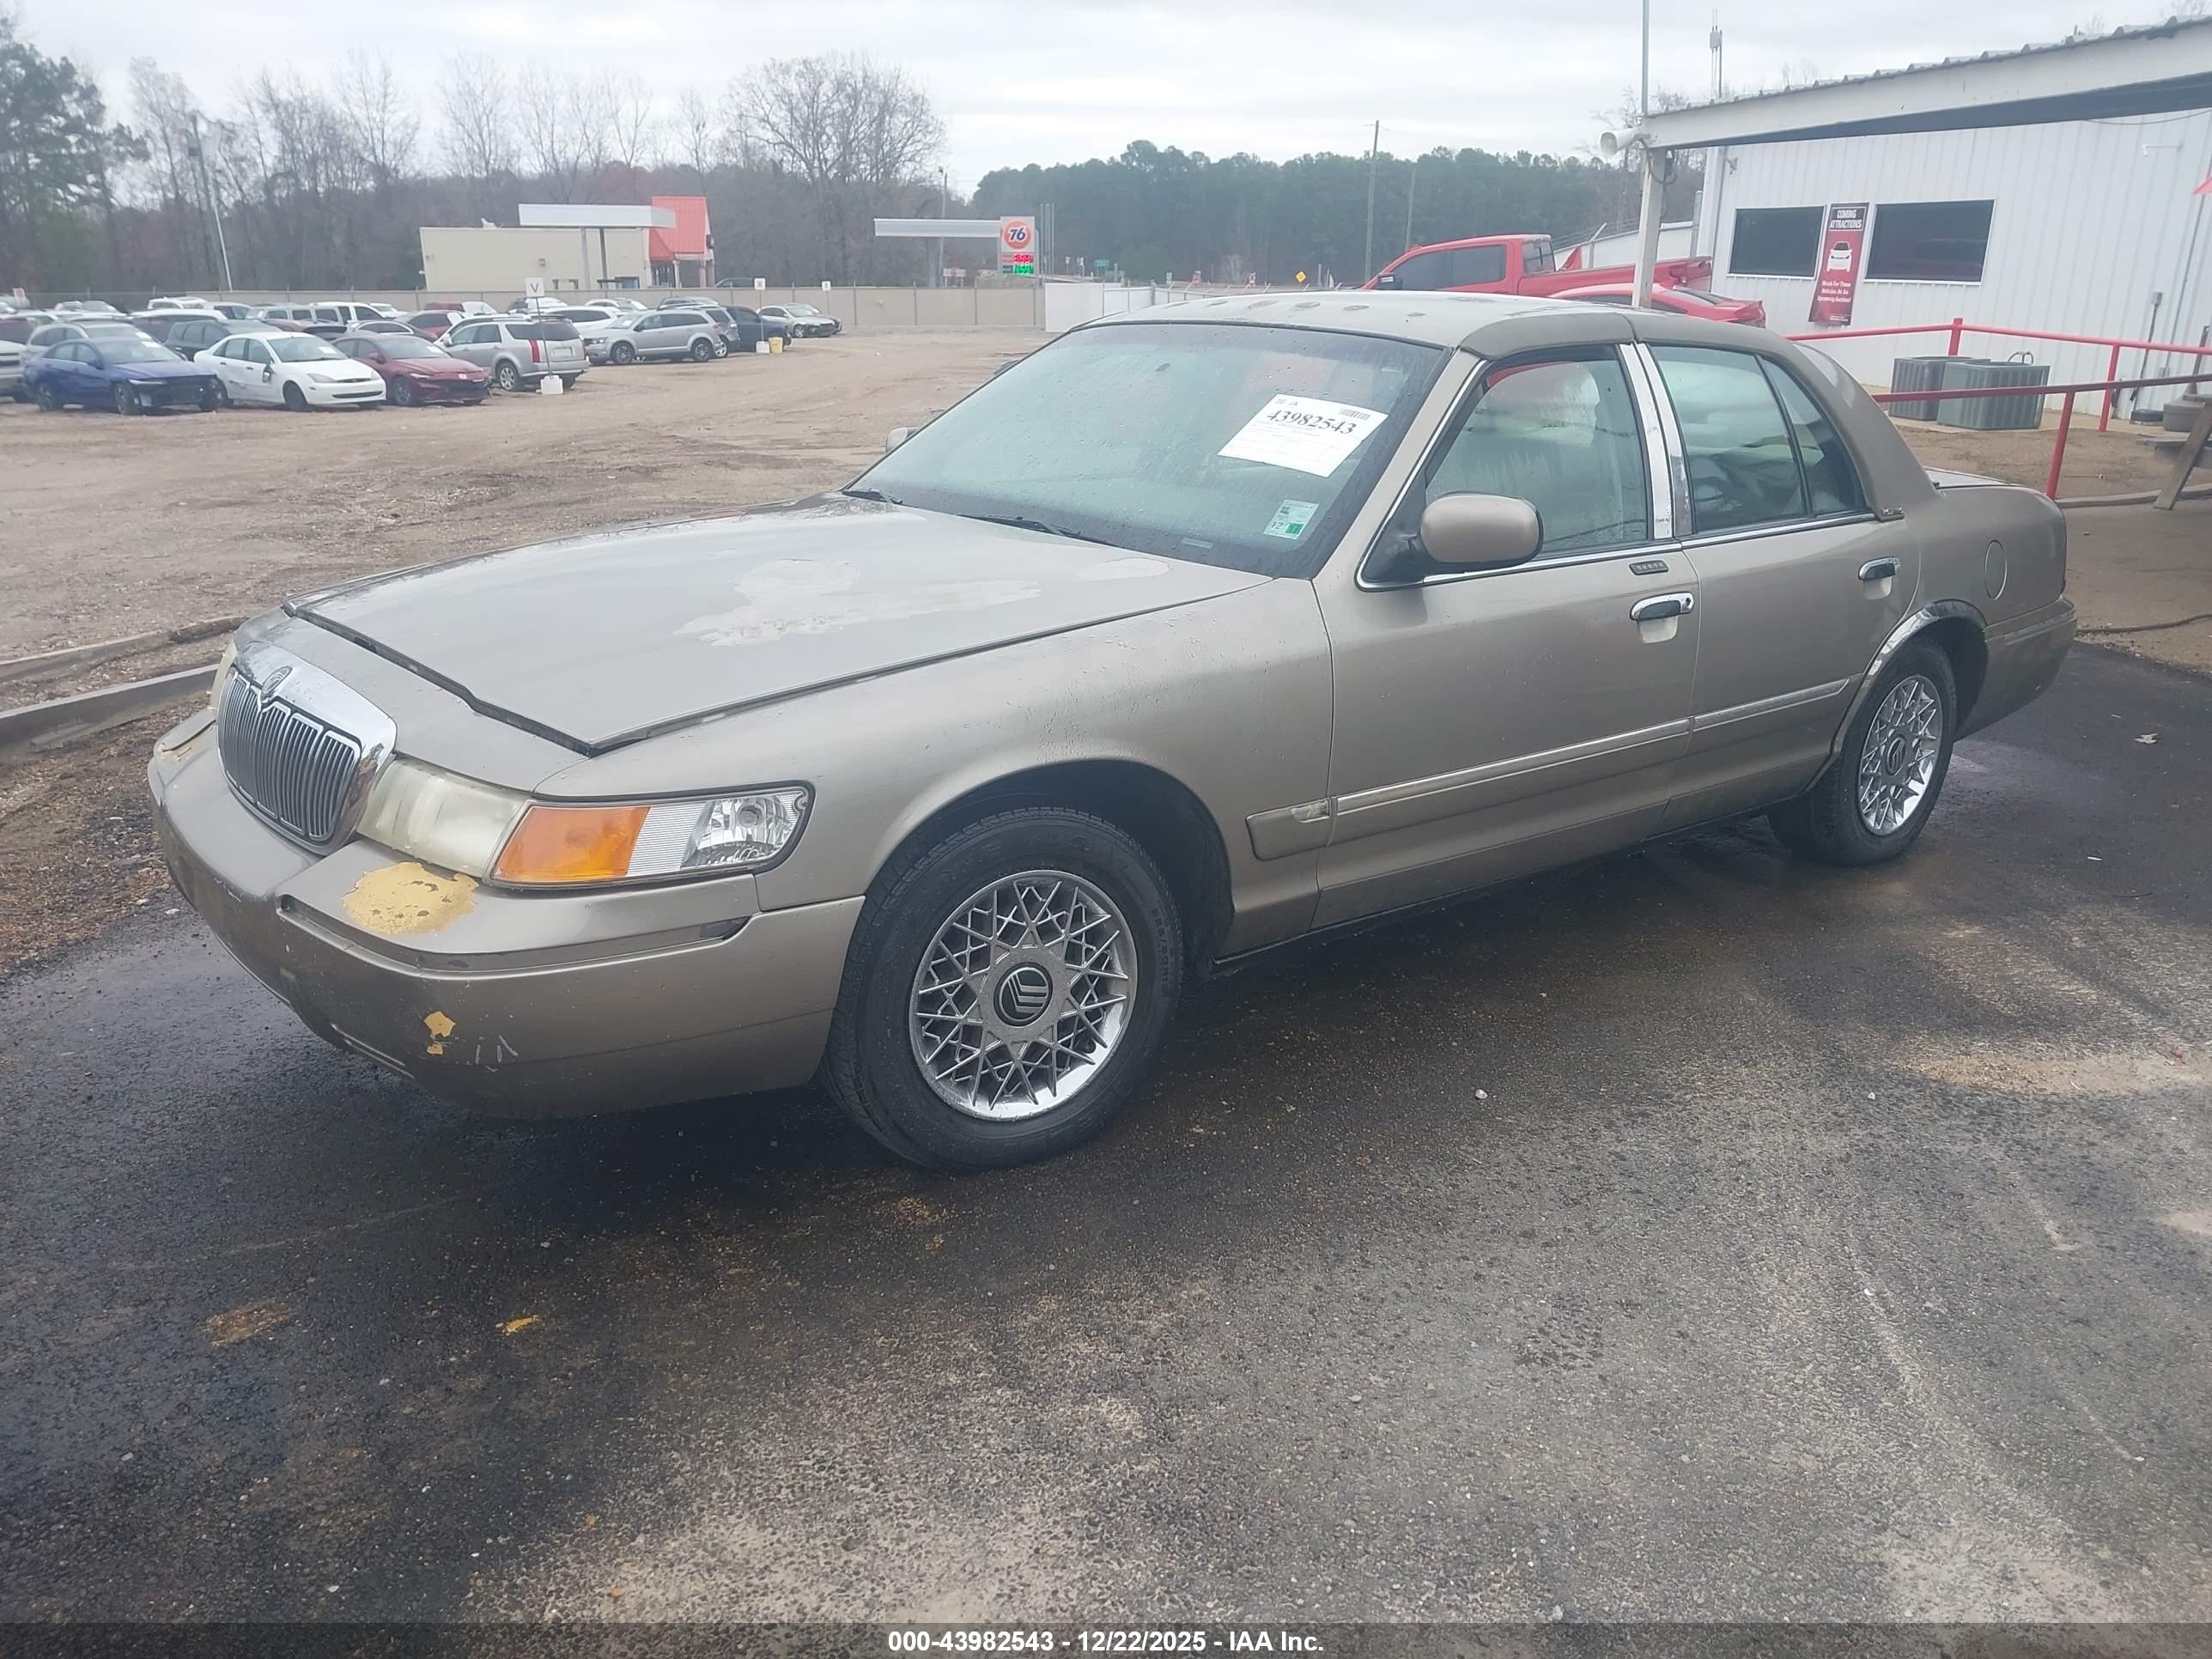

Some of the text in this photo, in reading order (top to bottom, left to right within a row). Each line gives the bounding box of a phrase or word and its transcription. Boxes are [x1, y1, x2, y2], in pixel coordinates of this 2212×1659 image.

[1837, 210, 1856, 218] COMING
[1830, 220, 1862, 228] ATTRACTIONS
[1009, 227, 1026, 241] 76
[530, 282, 539, 293] V
[1267, 410, 1357, 434] 43982543
